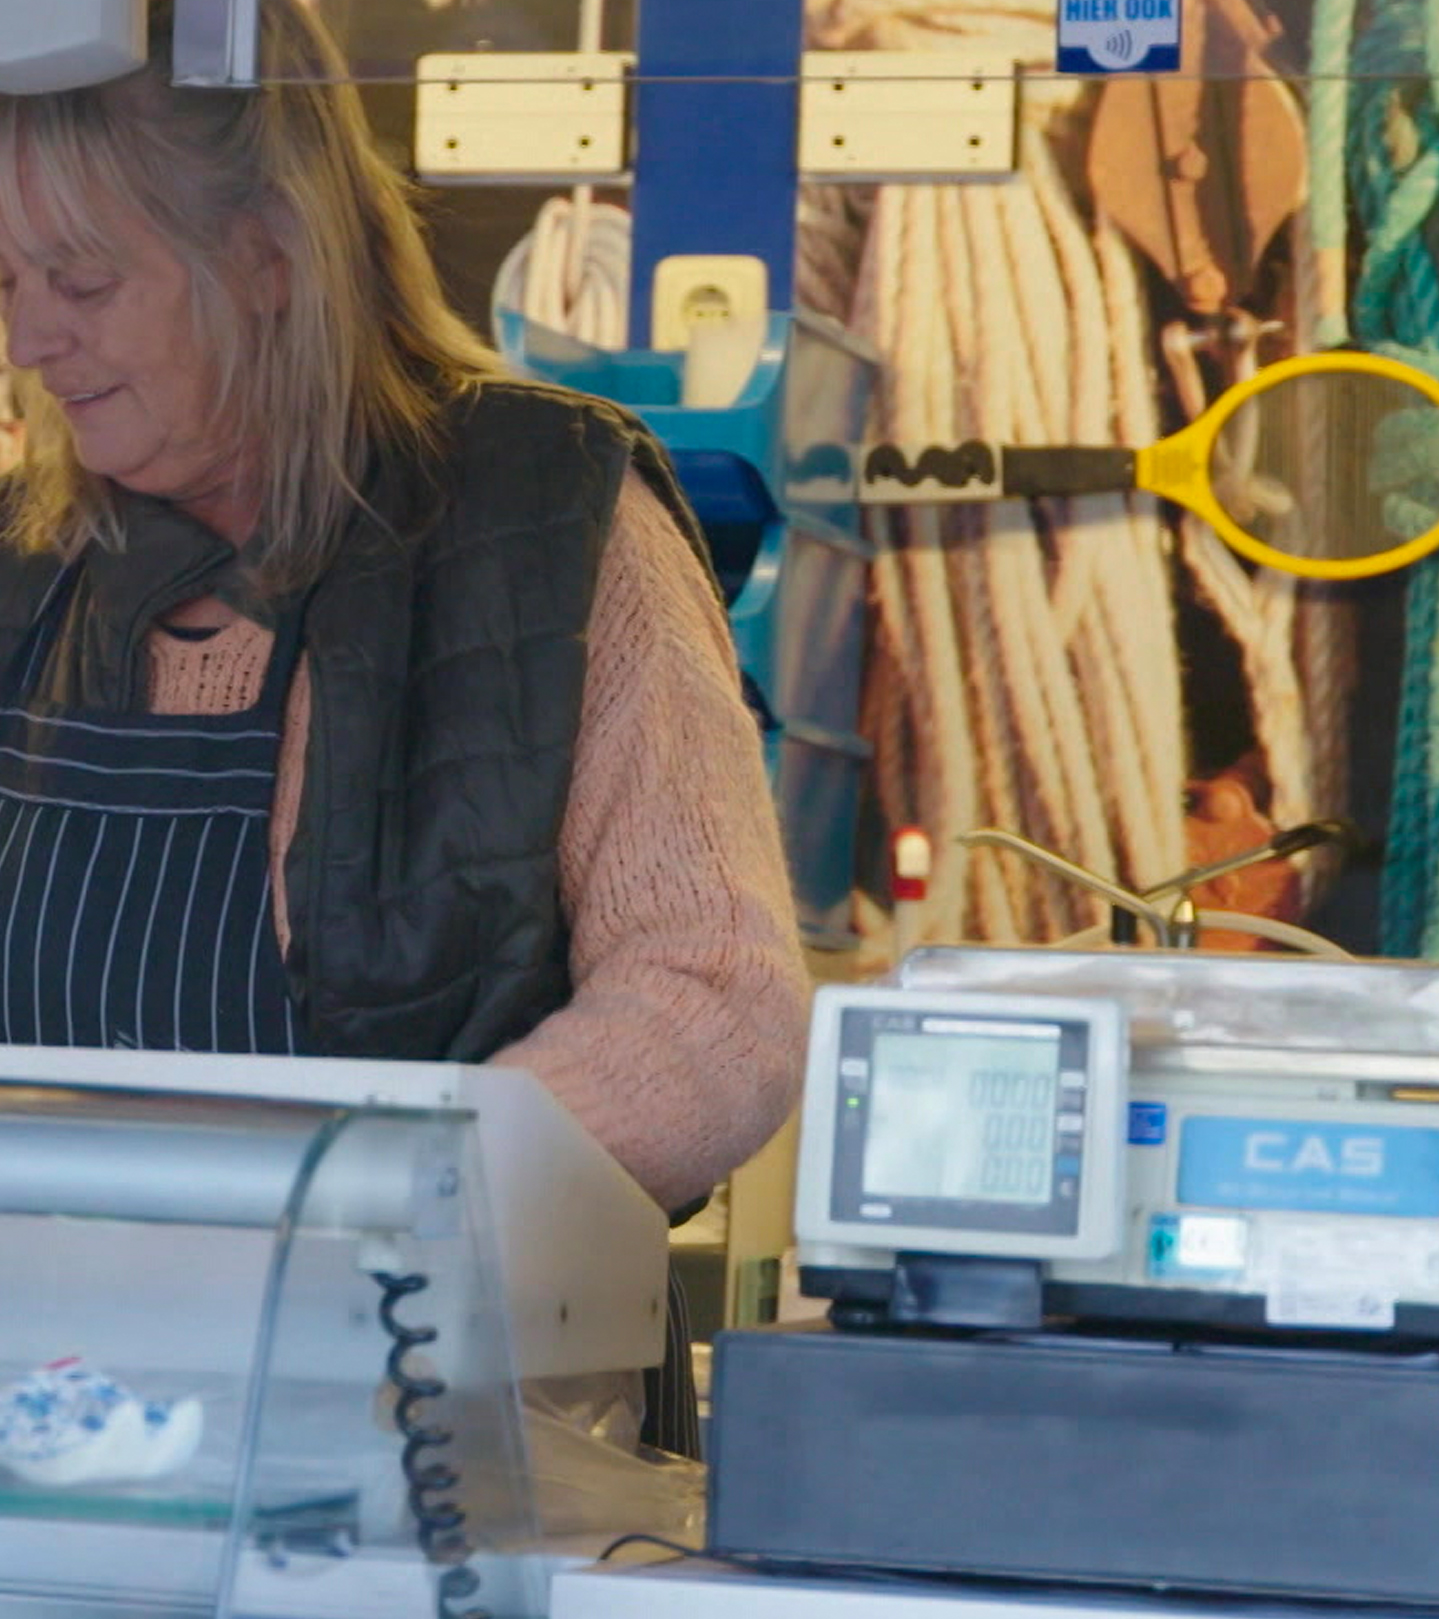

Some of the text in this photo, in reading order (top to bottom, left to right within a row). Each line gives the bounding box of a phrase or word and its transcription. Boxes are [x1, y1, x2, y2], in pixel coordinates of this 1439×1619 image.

[1066, 0, 1172, 21] HIER OOK
[1244, 1130, 1384, 1177] CAS
